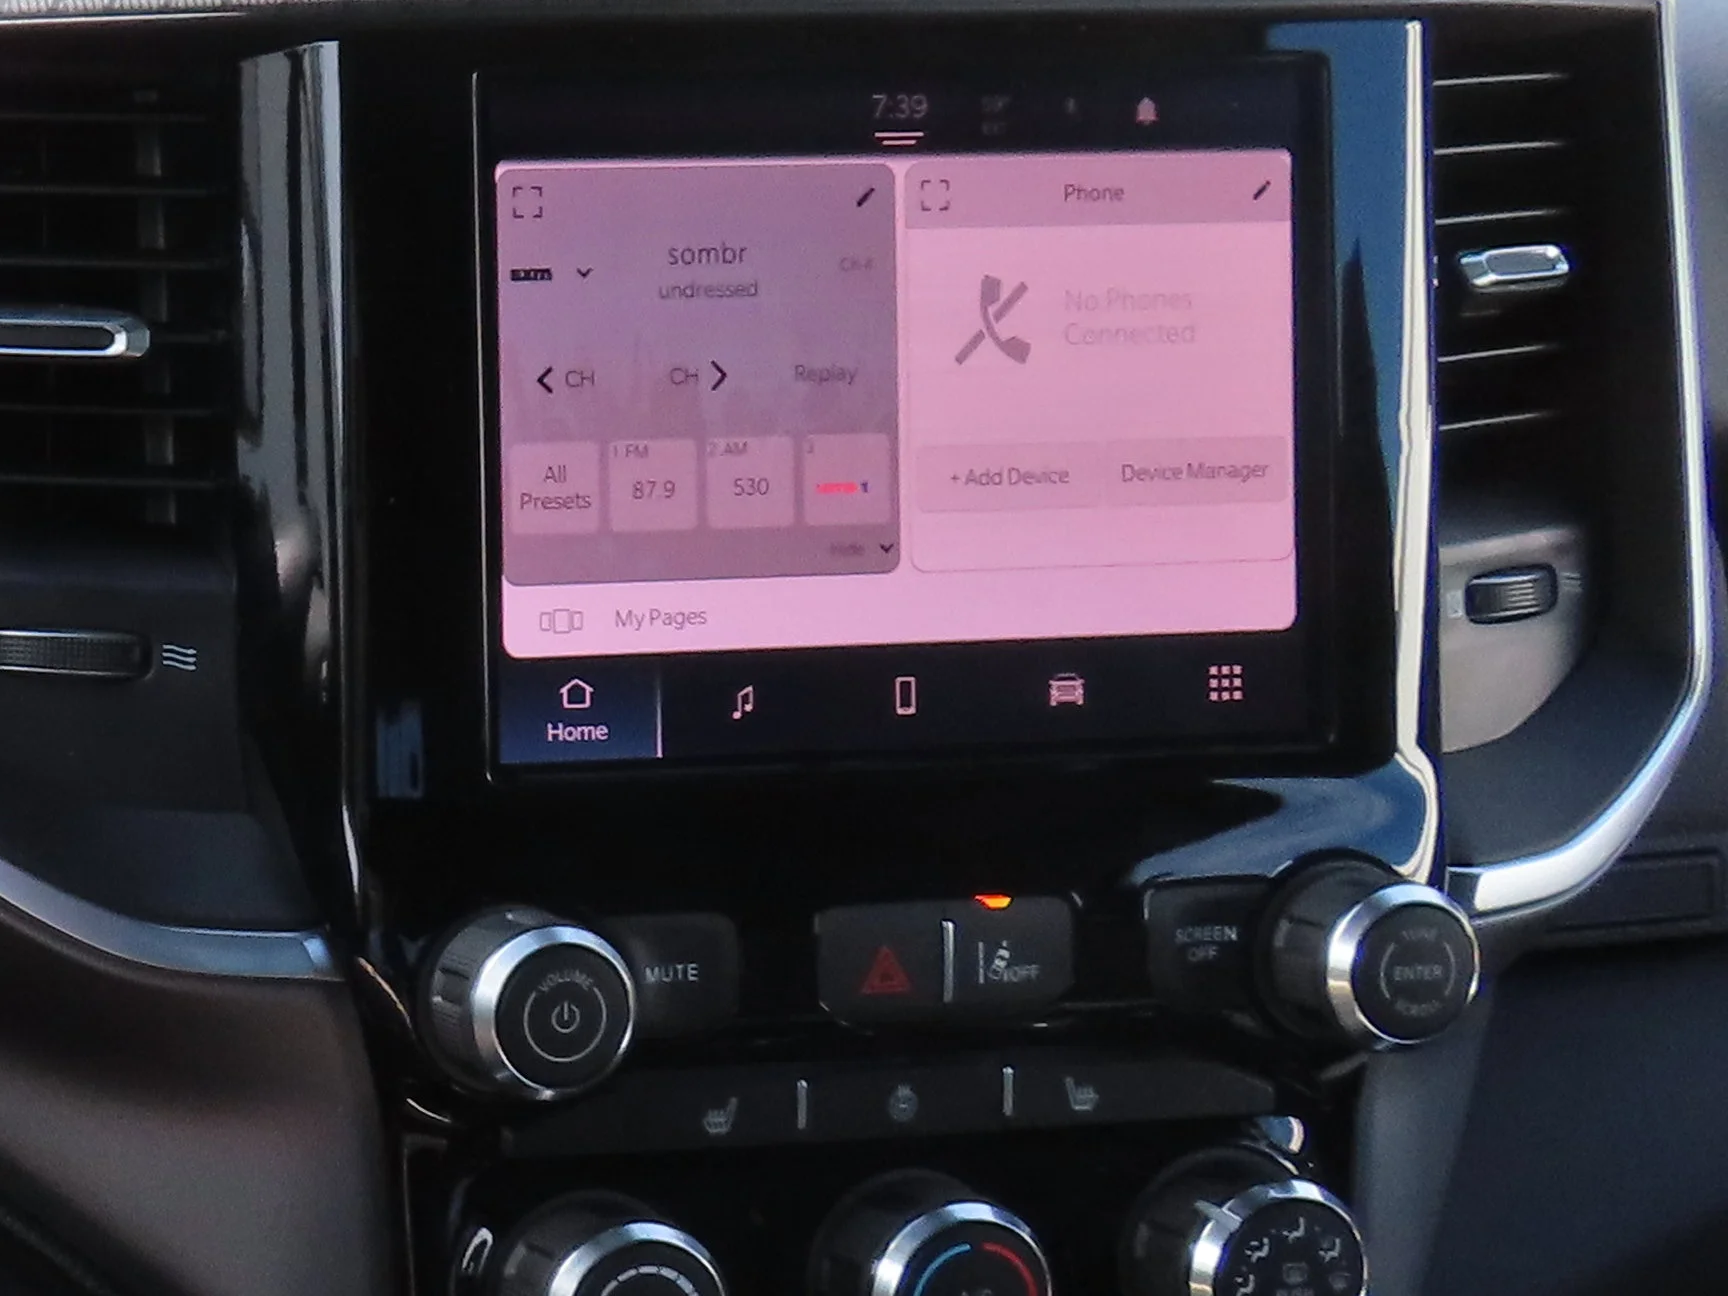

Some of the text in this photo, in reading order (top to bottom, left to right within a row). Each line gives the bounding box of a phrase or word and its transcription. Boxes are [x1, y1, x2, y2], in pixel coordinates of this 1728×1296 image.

[1063, 183, 1125, 202] Phone
[667, 242, 748, 266] sombr
[658, 281, 759, 301] undressed
[1063, 287, 1194, 312] No Phones
[1063, 323, 1198, 346] Connected
[565, 370, 595, 387] CH
[669, 368, 700, 385] CH
[794, 364, 858, 386] Replay
[544, 465, 567, 483] All
[964, 466, 1070, 486] Add Device
[1121, 461, 1269, 484] Device Manager
[520, 491, 592, 512] Presets
[615, 608, 708, 632] My Pages
[547, 722, 609, 742] Home
[1175, 925, 1238, 944] SCREEN
[1187, 947, 1219, 963] OFF
[537, 967, 596, 994] VOLUME
[644, 962, 700, 984] MUTE
[1393, 964, 1444, 982] ENTER
